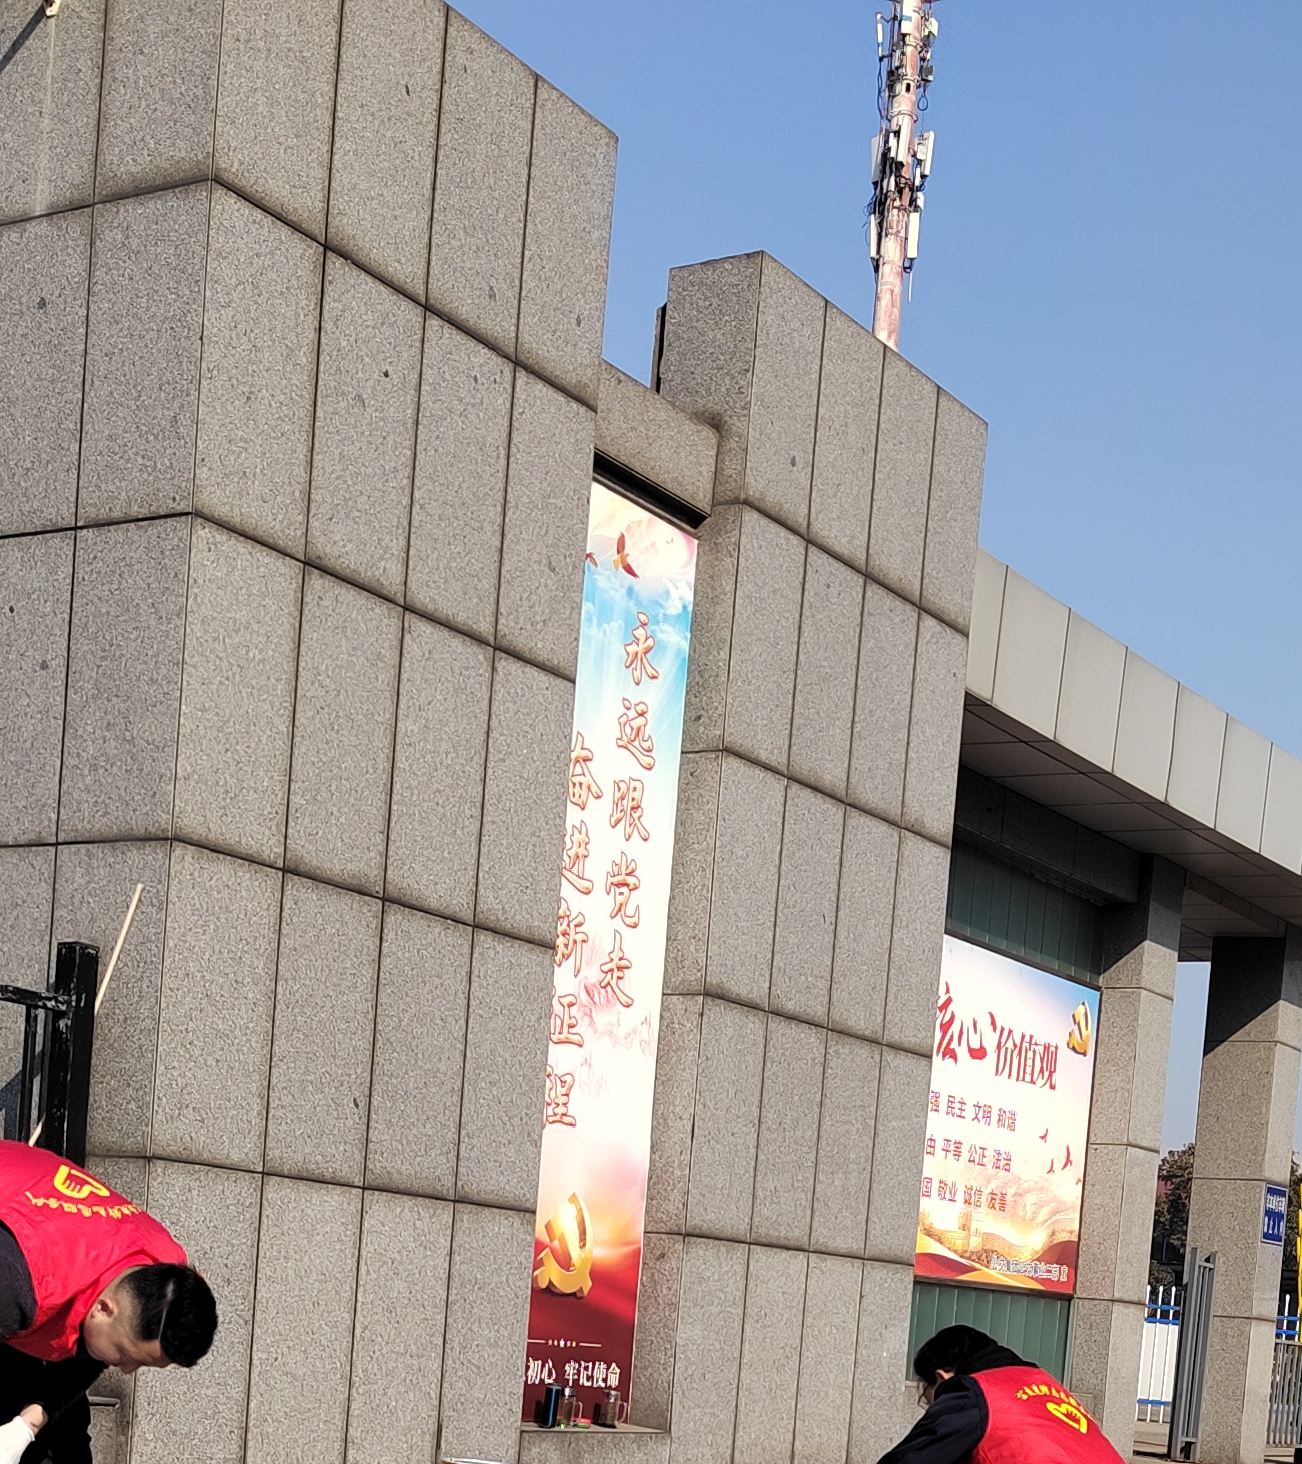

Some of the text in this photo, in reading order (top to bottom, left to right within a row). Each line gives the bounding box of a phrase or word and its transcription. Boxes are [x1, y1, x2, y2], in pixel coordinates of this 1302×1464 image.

[599, 611, 660, 1007] 永远跟党走
[945, 1094, 967, 1119] 民主
[971, 1101, 993, 1127] 文明
[996, 1107, 1017, 1132] 和谐
[941, 1138, 964, 1162] 平等
[967, 1143, 988, 1167] 公正
[991, 1149, 1012, 1173] 法治
[937, 1178, 958, 1203] 敬业
[962, 1184, 983, 1208] 诚信
[987, 1188, 1008, 1213] 友善
[564, 1359, 621, 1389] 牢记使命
